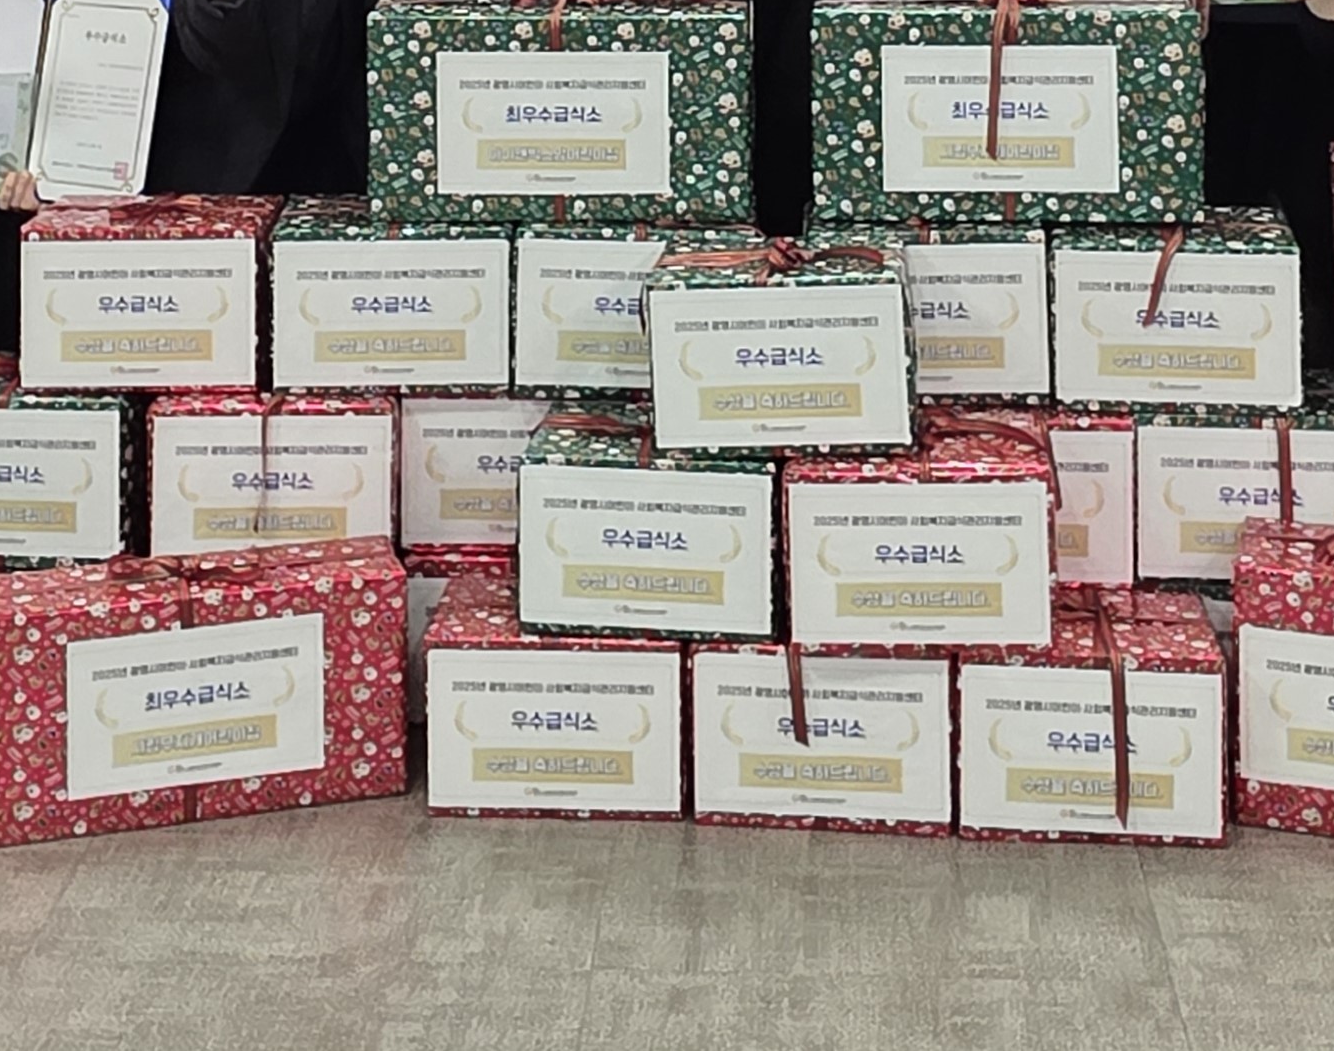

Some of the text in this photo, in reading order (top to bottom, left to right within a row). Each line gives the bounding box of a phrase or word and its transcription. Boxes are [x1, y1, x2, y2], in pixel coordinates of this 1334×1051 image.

[506, 105, 602, 122] 최우수급식소
[951, 101, 1049, 118] 최우급식소
[99, 295, 180, 312] 우수급식소
[353, 296, 435, 313] 우수급식소
[594, 297, 640, 315] 우수급
[912, 302, 970, 319] 급식소
[736, 347, 825, 367] 우수급식소
[477, 456, 522, 473] 우수급
[232, 472, 314, 490] 우수급식소
[603, 528, 691, 551] 우수급식소
[876, 543, 967, 562] 우수급식소
[144, 681, 250, 712] 최우수급식소
[512, 711, 599, 731] 우수급식소
